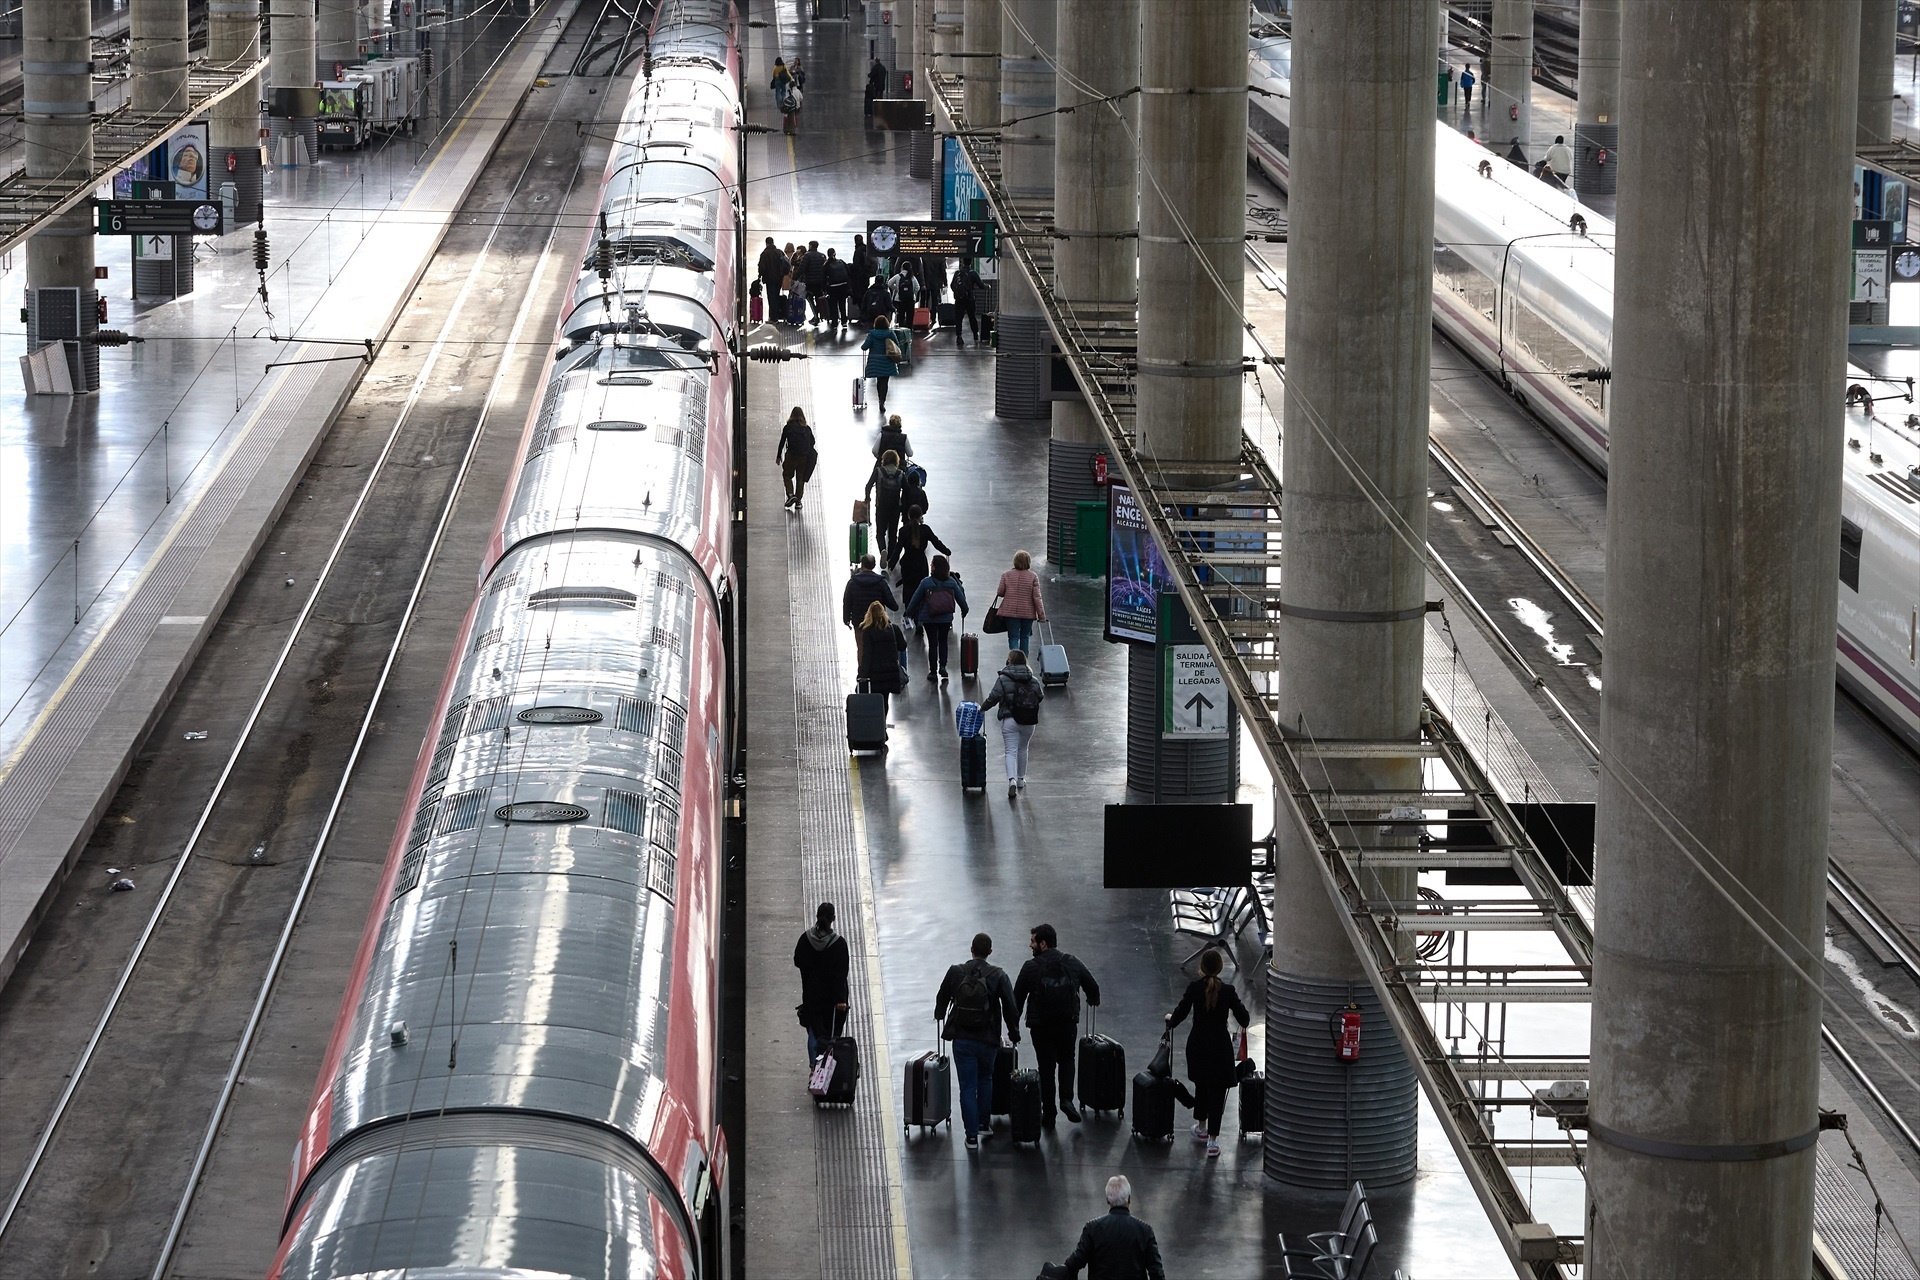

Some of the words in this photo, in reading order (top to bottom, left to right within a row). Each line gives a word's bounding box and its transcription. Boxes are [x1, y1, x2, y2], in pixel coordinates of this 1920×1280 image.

[111, 215, 122, 231] 6
[972, 236, 982, 253] 7
[1116, 519, 1139, 528] ALCÁZAR
[1194, 669, 1205, 677] DE
[1178, 677, 1220, 685] LLEGADAS
